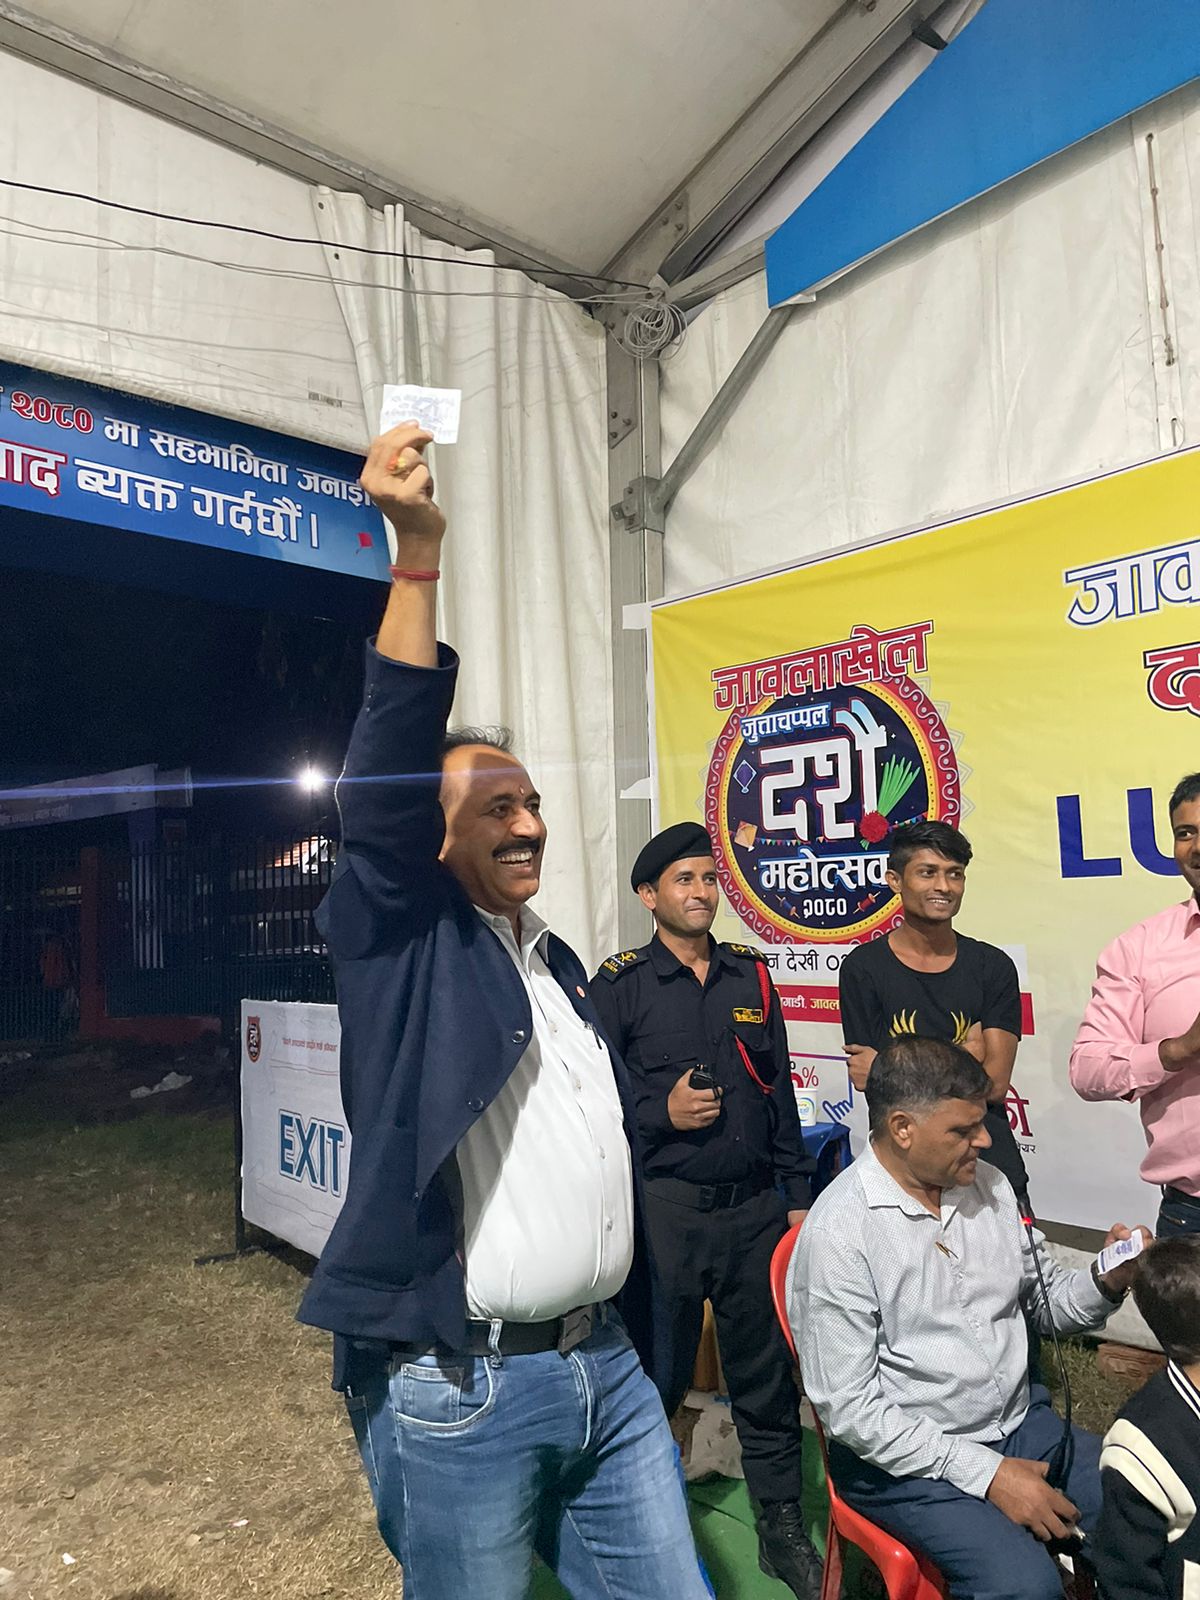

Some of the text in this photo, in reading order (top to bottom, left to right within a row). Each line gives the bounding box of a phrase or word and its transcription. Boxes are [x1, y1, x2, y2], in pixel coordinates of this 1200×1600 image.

[0, 440, 67, 497] ाद
[10, 390, 95, 434] २०८०
[104, 416, 140, 449] मा
[149, 428, 290, 486] सहभागिता
[1063, 538, 1200, 626] जाव
[711, 620, 934, 710] जावलाखेल
[1056, 787, 1184, 879] LU
[759, 847, 890, 893] महोत्सव
[802, 897, 848, 918] २०८०
[786, 946, 819, 972] देखी
[810, 998, 840, 1010] जावल
[278, 1109, 345, 1198] EXIT
